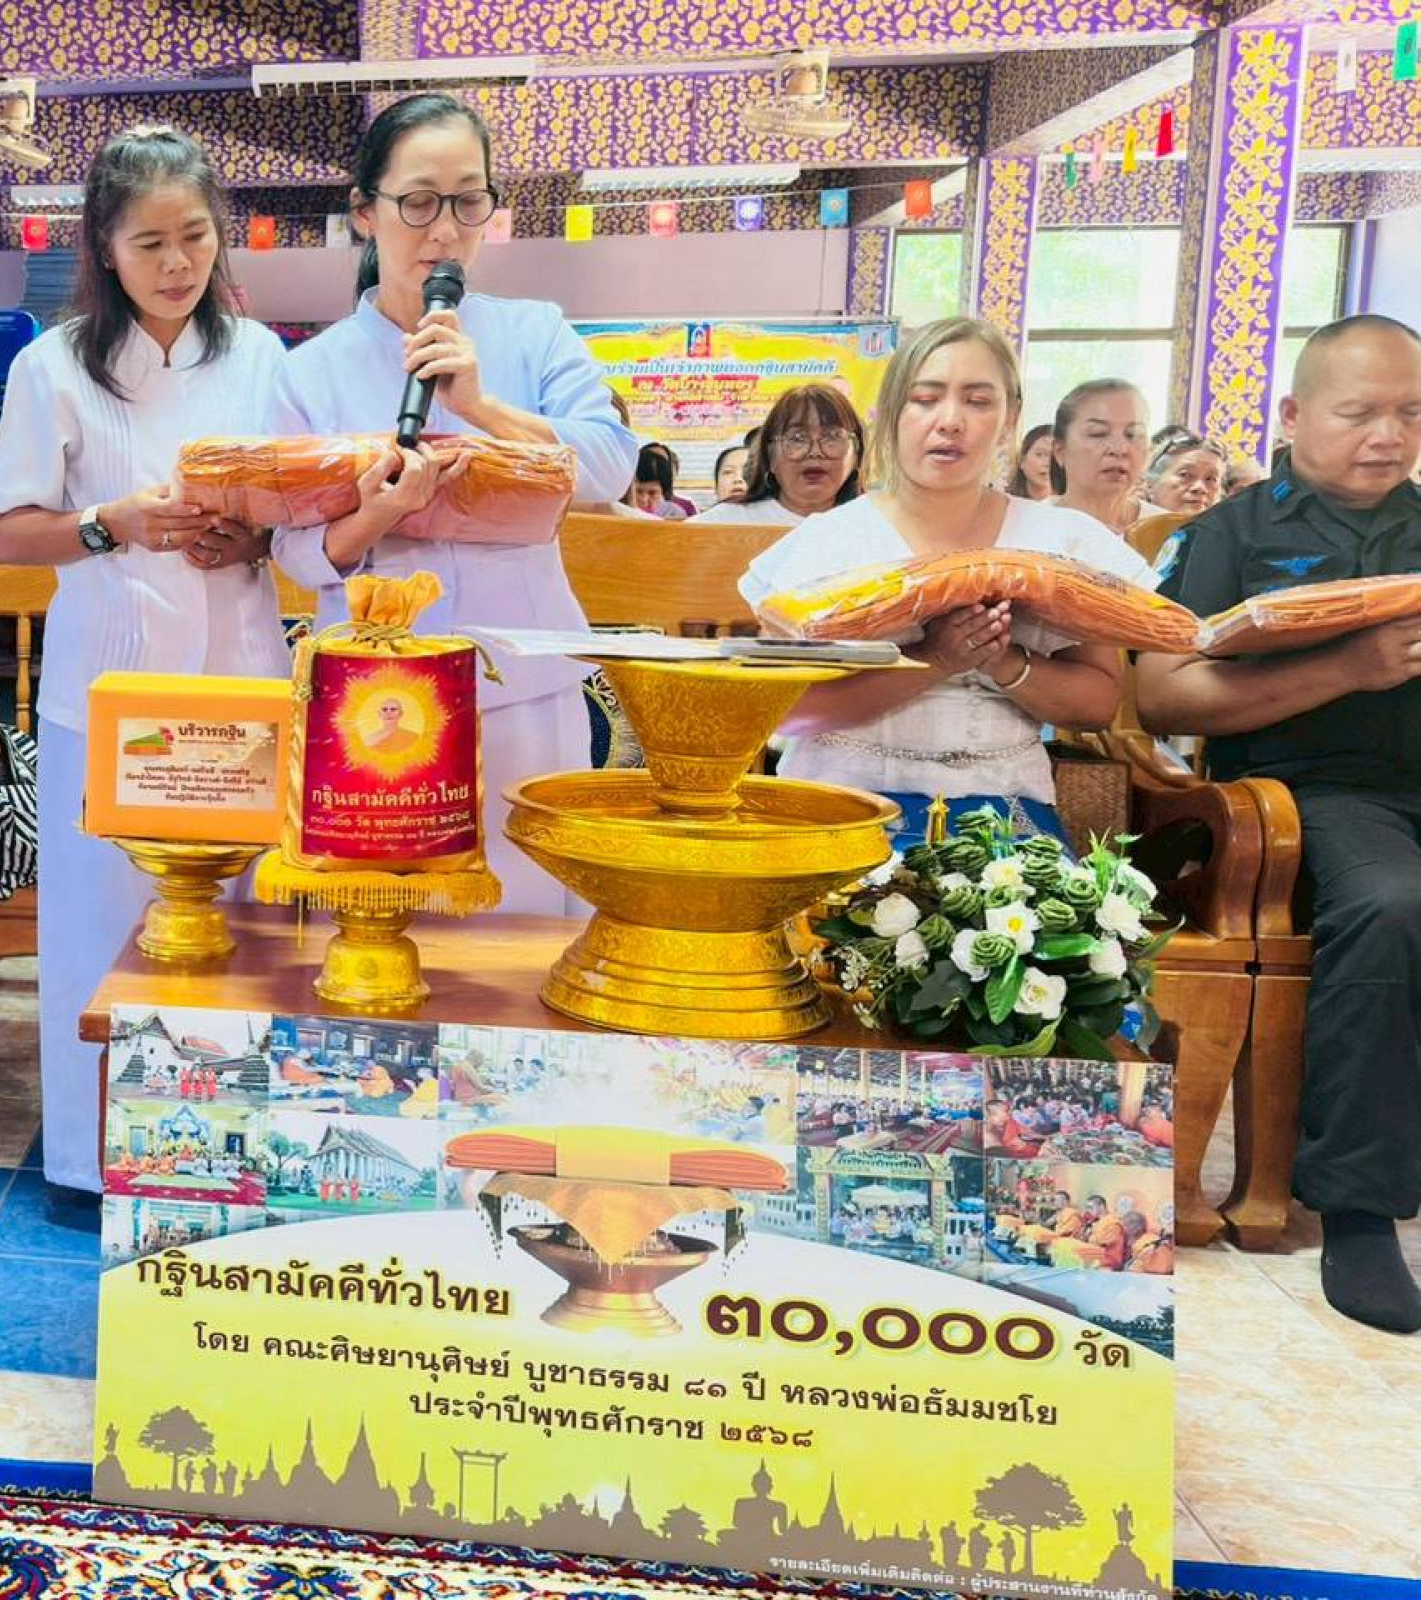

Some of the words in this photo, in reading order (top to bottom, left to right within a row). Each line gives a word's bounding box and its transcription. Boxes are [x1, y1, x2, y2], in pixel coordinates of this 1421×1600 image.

[178, 722, 246, 740] บริวารกฐิน
[312, 780, 469, 809] กฐินสามัคคีทั่วไทย
[136, 1249, 511, 1316] กฐินสามัคคีทั่วไทย
[705, 1293, 1055, 1361] ๓๐,๐๐๐
[1074, 1330, 1131, 1368] วัด
[194, 1321, 250, 1353] โดย
[264, 1333, 510, 1382] คณะศิษยานุศิษย์
[523, 1357, 669, 1393] บูชาธรรม
[684, 1378, 728, 1399] ๘๑
[742, 1371, 766, 1401] ปี
[781, 1381, 1058, 1426] หลวงพ่อธัมมชโย
[409, 1391, 704, 1440] ประจำปีพุทธศักราช
[720, 1420, 814, 1448] ๒๕๖๘
